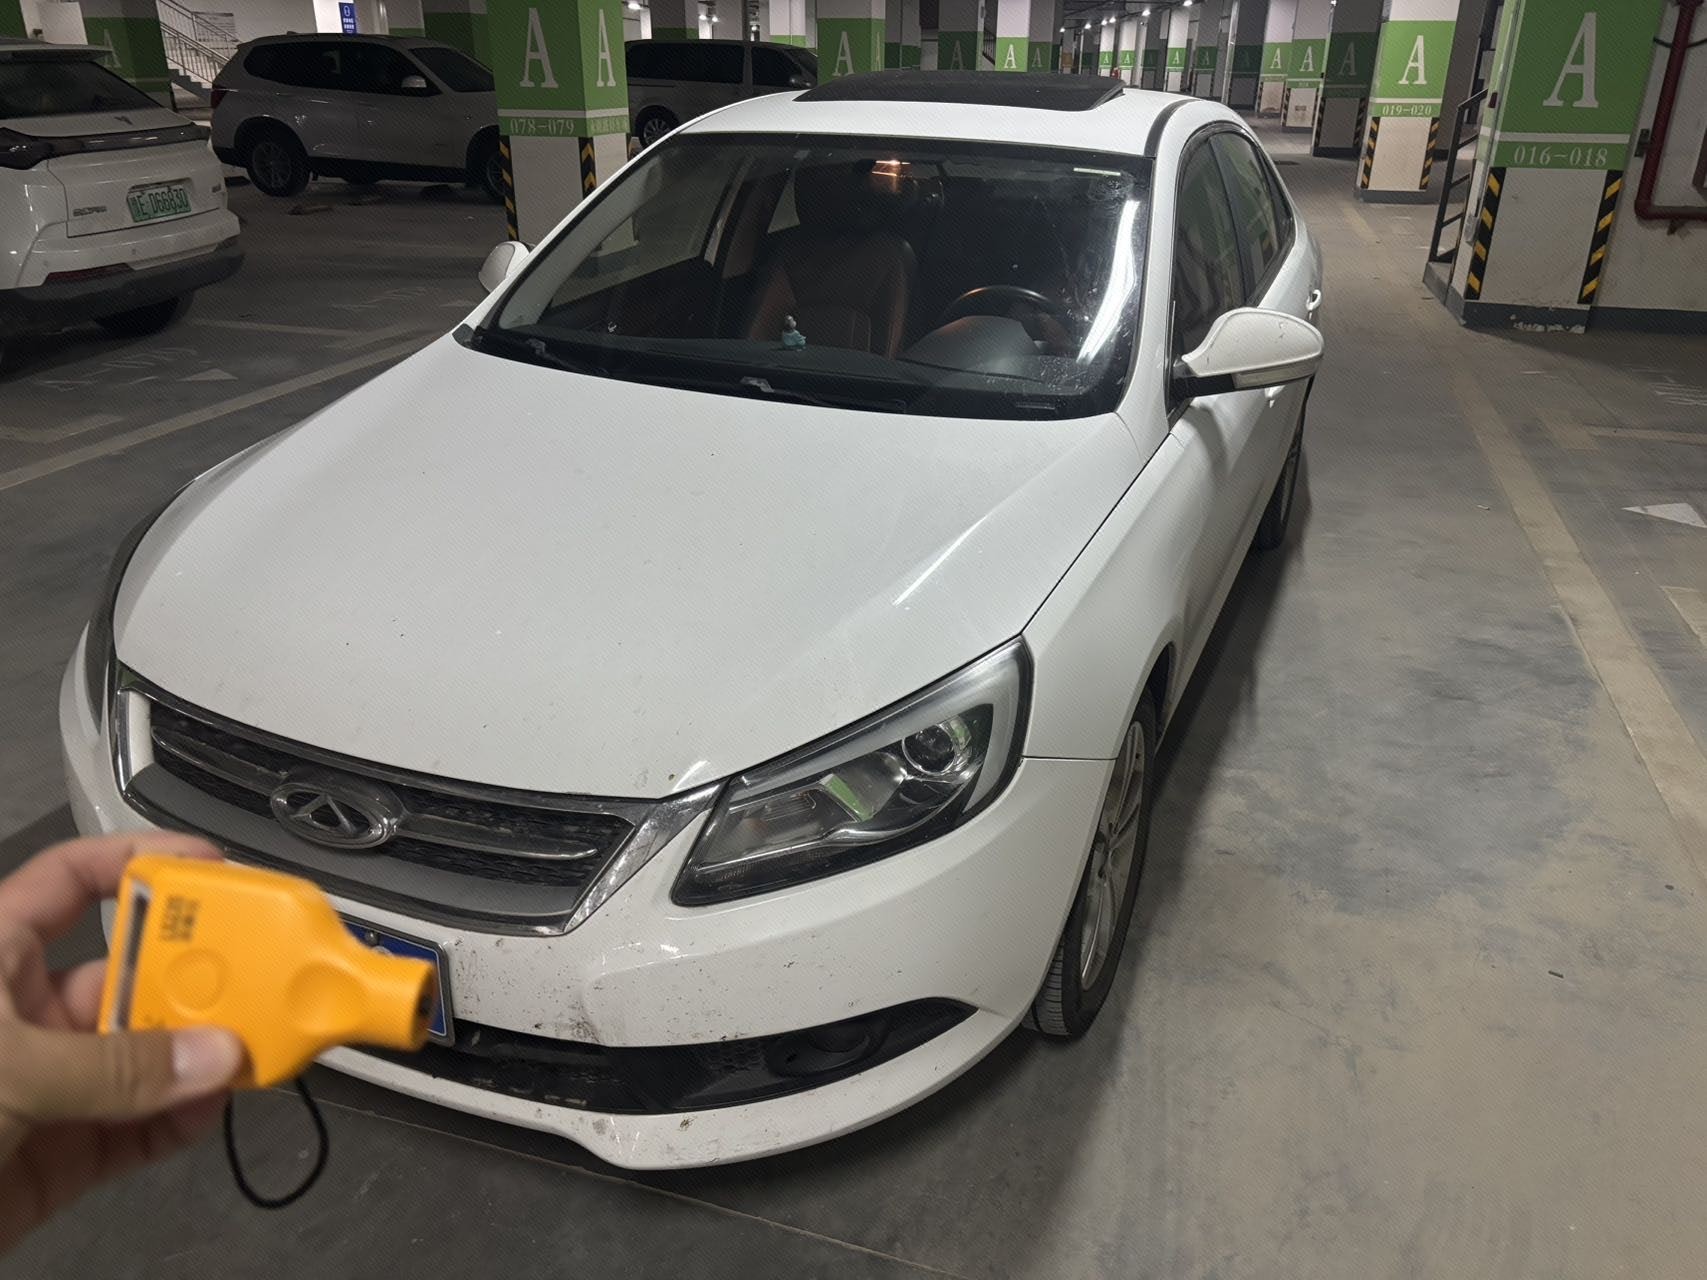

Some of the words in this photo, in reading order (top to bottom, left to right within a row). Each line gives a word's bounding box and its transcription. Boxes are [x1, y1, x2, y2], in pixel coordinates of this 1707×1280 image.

[519, 8, 559, 88] A
[596, 9, 616, 87] A
[832, 31, 855, 77] A
[950, 40, 964, 70] A
[1004, 44, 1017, 69] A
[1031, 47, 1043, 68] A
[1172, 50, 1180, 65] A
[1270, 47, 1282, 69] A
[1300, 45, 1314, 72] A
[1339, 41, 1357, 76] A
[1398, 35, 1428, 85] A
[1542, 12, 1599, 108] A
[1381, 105, 1432, 116] 019-020
[510, 118, 575, 135] 078-079
[1513, 145, 1608, 166] 016-018
